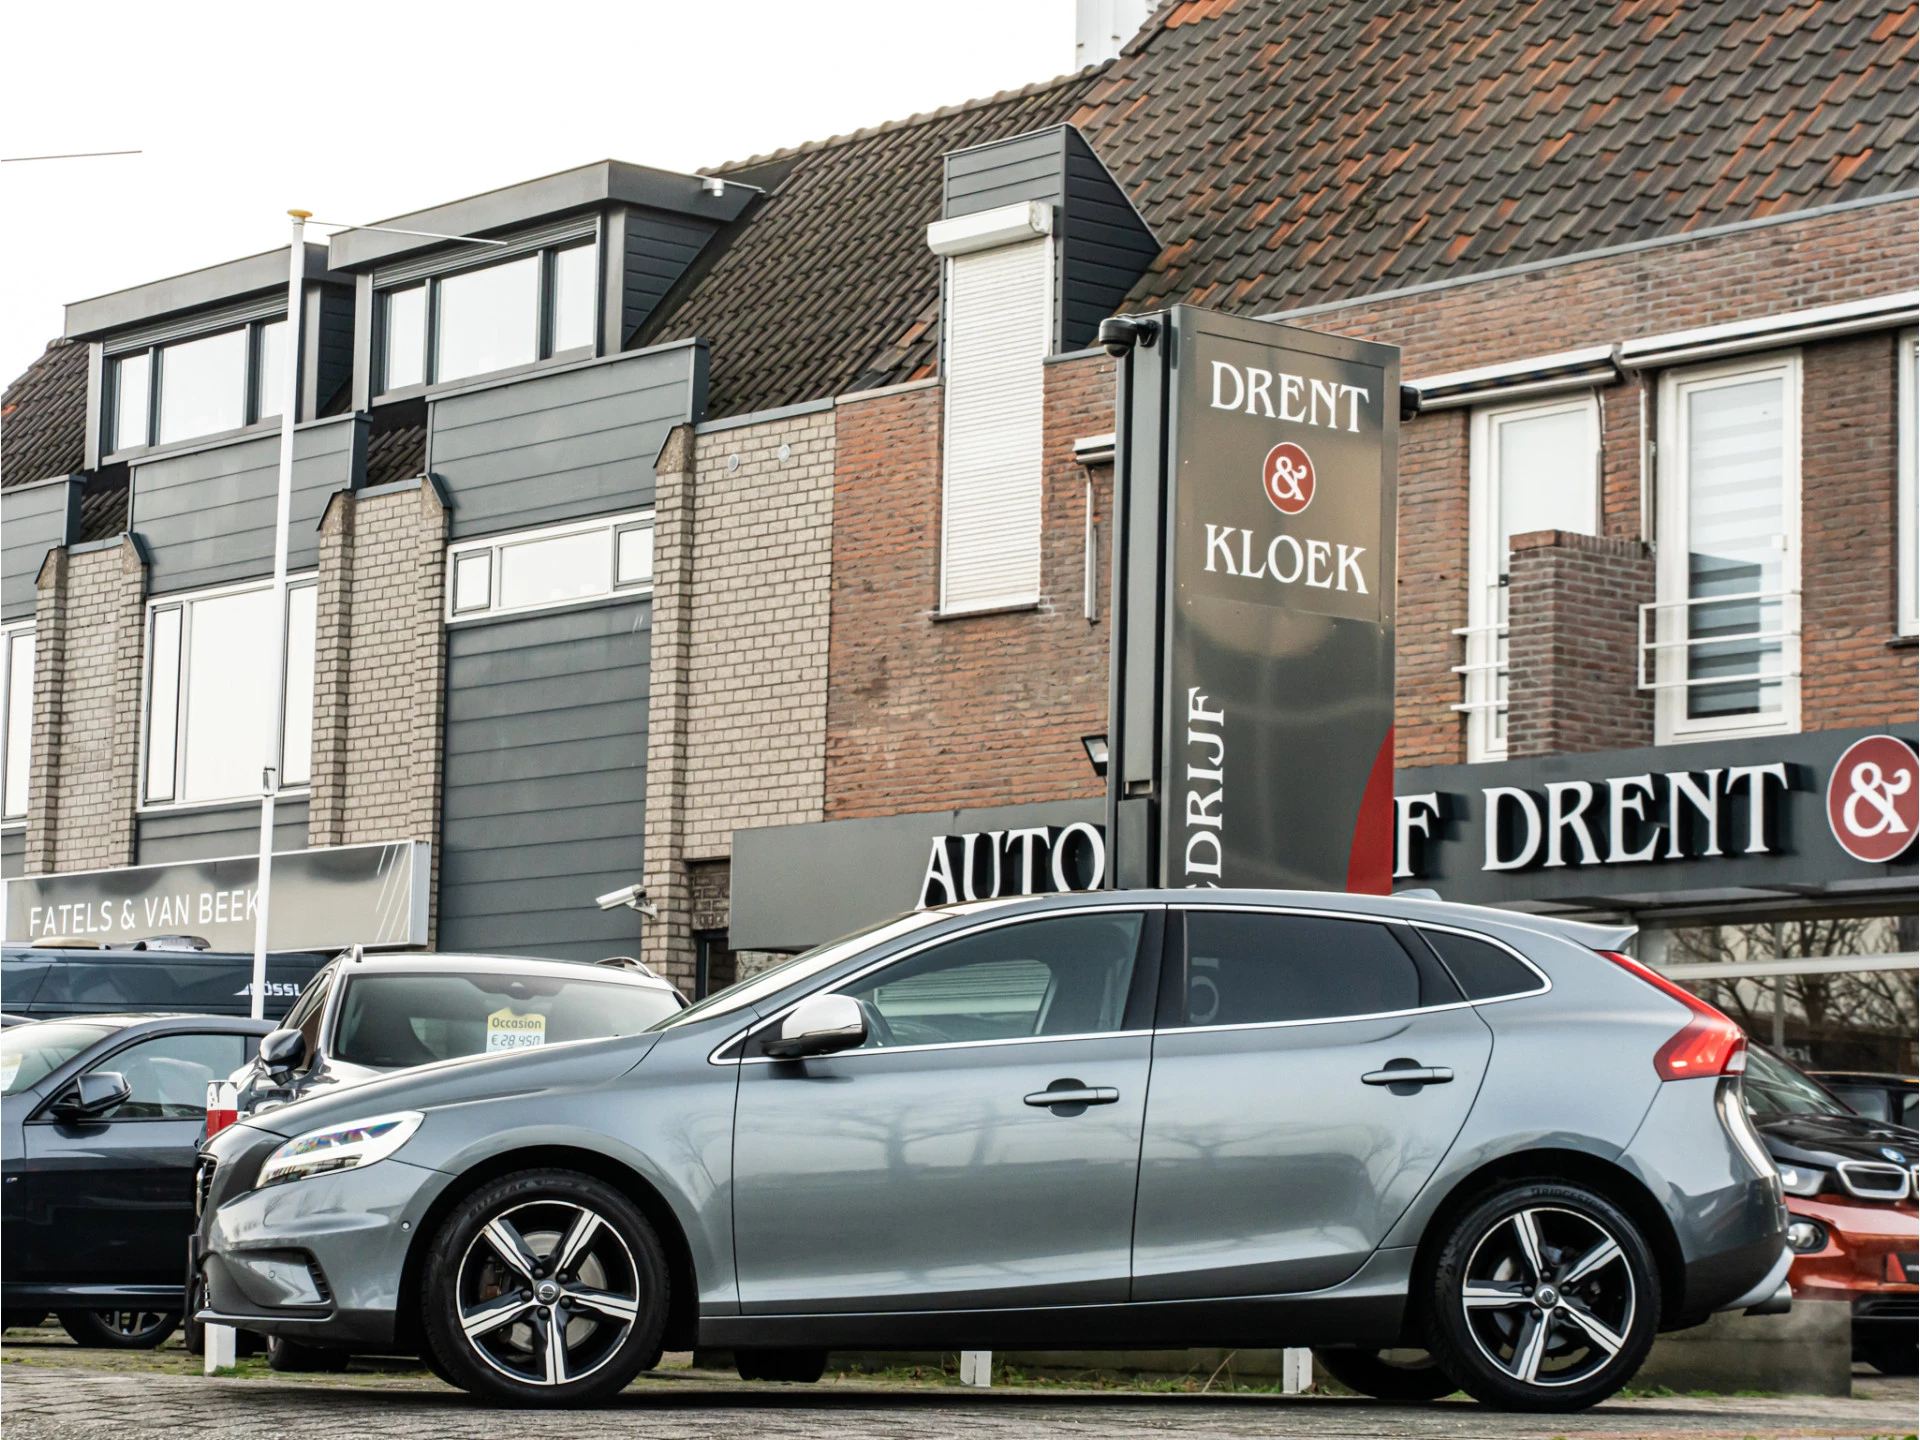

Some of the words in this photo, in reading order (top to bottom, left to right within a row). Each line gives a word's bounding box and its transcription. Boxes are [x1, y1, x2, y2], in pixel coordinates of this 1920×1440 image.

[1210, 360, 1370, 433] DRENT
[1271, 456, 1305, 501] &
[1204, 523, 1369, 595] KLOEK
[1185, 686, 1225, 888] DRIJF
[1482, 762, 1789, 871] DRENT
[1843, 761, 1912, 838] &
[29, 901, 113, 937] FATELS
[120, 899, 136, 930] &
[144, 893, 190, 928] VAN
[199, 889, 259, 924] BEEK
[492, 1017, 542, 1029] Occasion
